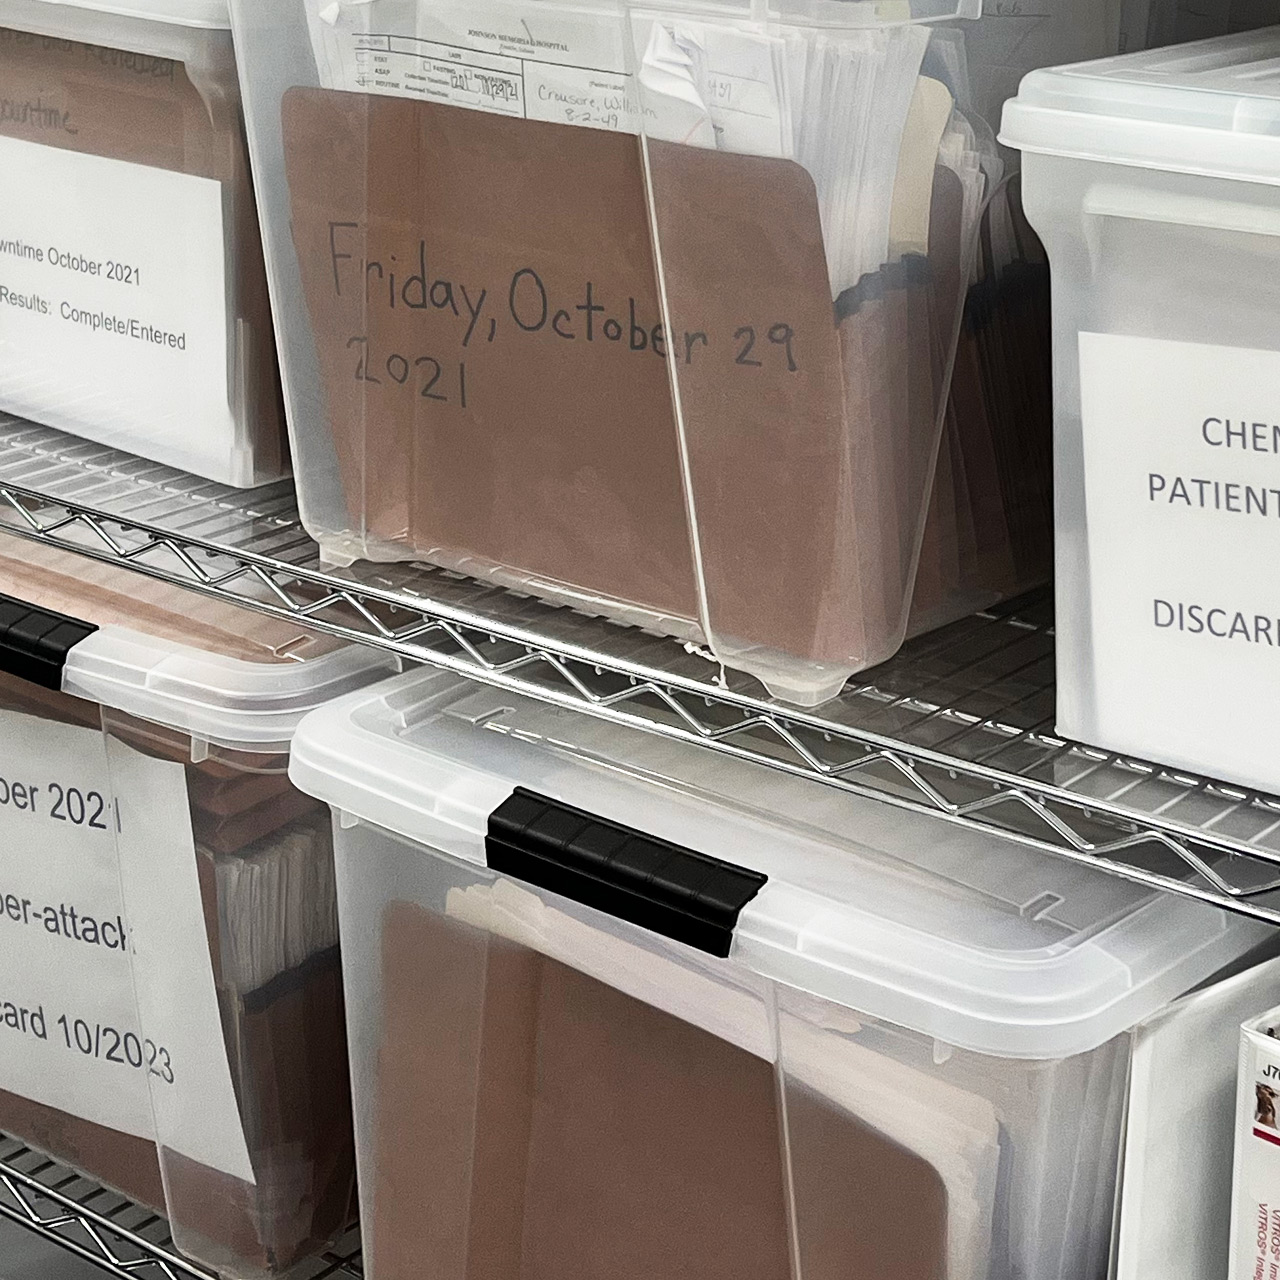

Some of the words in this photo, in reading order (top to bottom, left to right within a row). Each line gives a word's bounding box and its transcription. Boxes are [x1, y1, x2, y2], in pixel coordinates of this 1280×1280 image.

[47, 247, 102, 276] October
[106, 261, 140, 286] 2021
[328, 222, 496, 347] Friday,
[509, 268, 709, 364] October
[734, 323, 798, 372] 29
[0, 285, 52, 315] Results:
[60, 302, 186, 350] Complete/Entered
[346, 336, 467, 408] 2021
[58, 1014, 174, 1084] 10/2023
